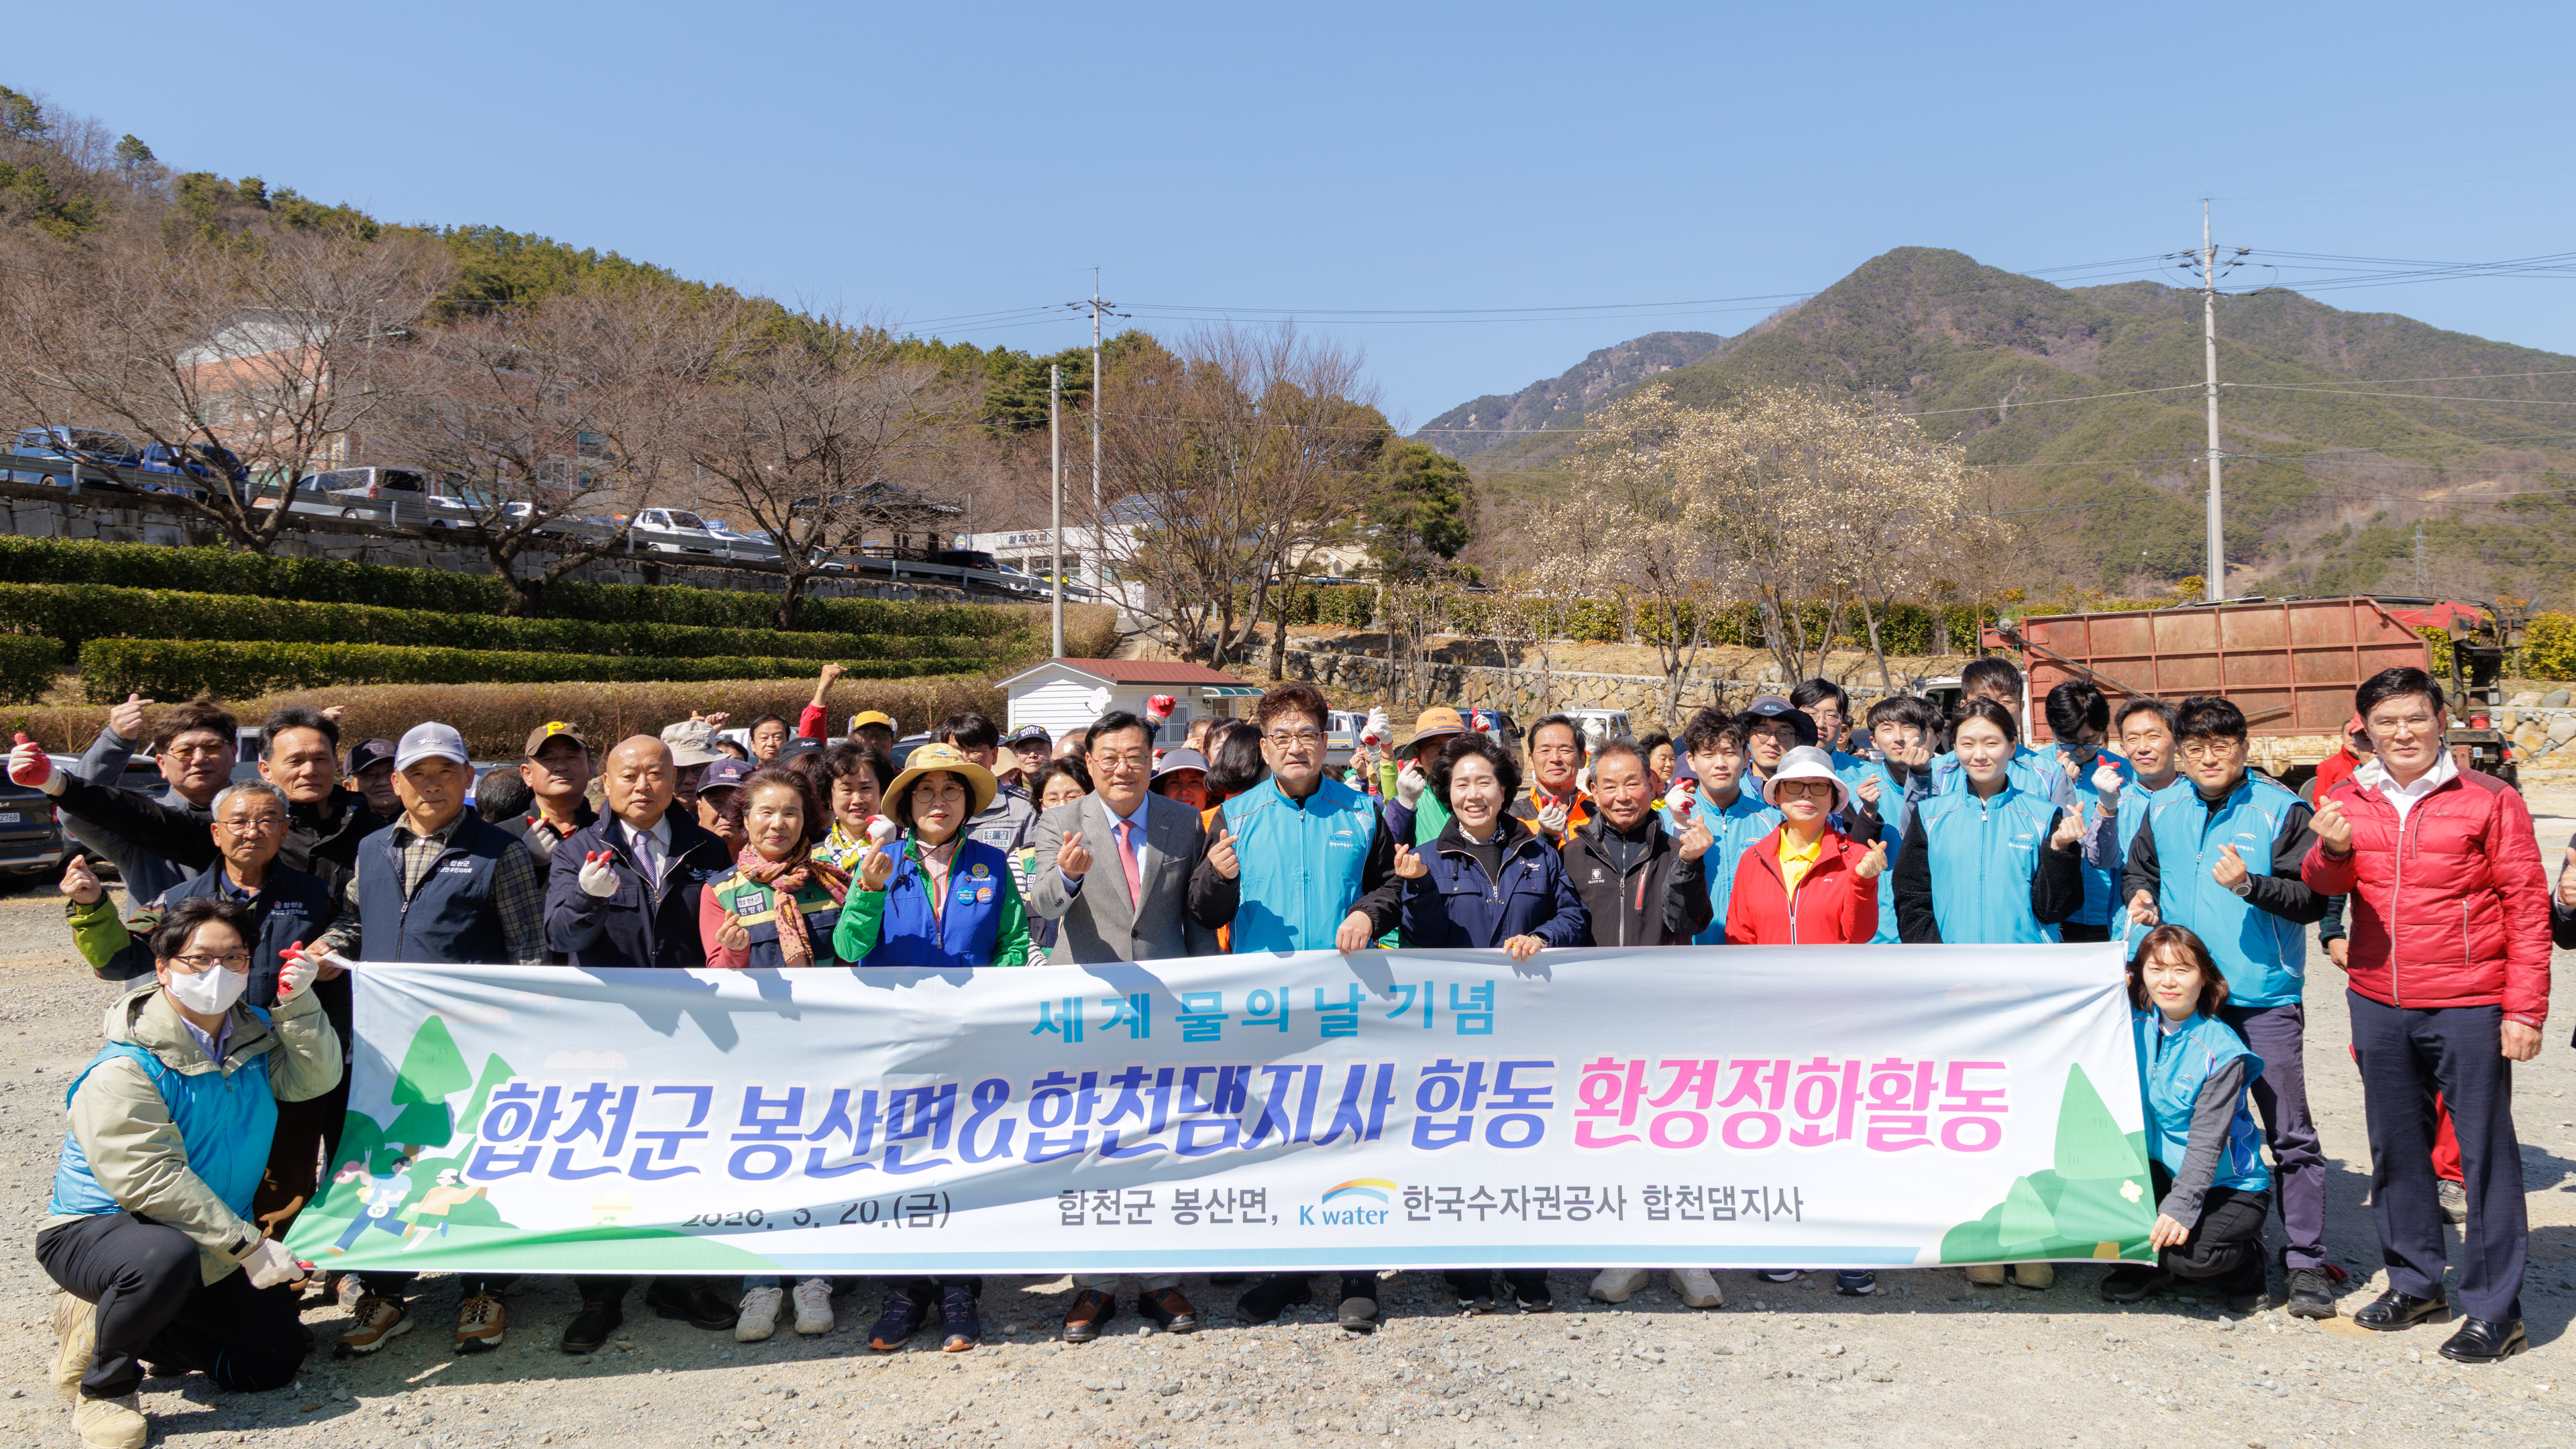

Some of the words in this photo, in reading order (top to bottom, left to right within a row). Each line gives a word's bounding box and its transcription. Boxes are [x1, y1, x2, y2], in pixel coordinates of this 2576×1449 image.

[986, 830, 1008, 840] 경찰
[739, 896, 761, 906] 합천군
[739, 903, 764, 916] 민방위
[1030, 994, 1150, 1043] 세계
[466, 1082, 714, 1181] 합천군
[1411, 1059, 1555, 1150] 합동
[1574, 1057, 2009, 1152] 환경정화활동
[1058, 1189, 1155, 1226] 합천군
[1171, 1187, 1277, 1226] 봉산면,
[1300, 1205, 1315, 1225] K
[1322, 1206, 1388, 1226] water
[1642, 1185, 1803, 1222] 합천댐지사
